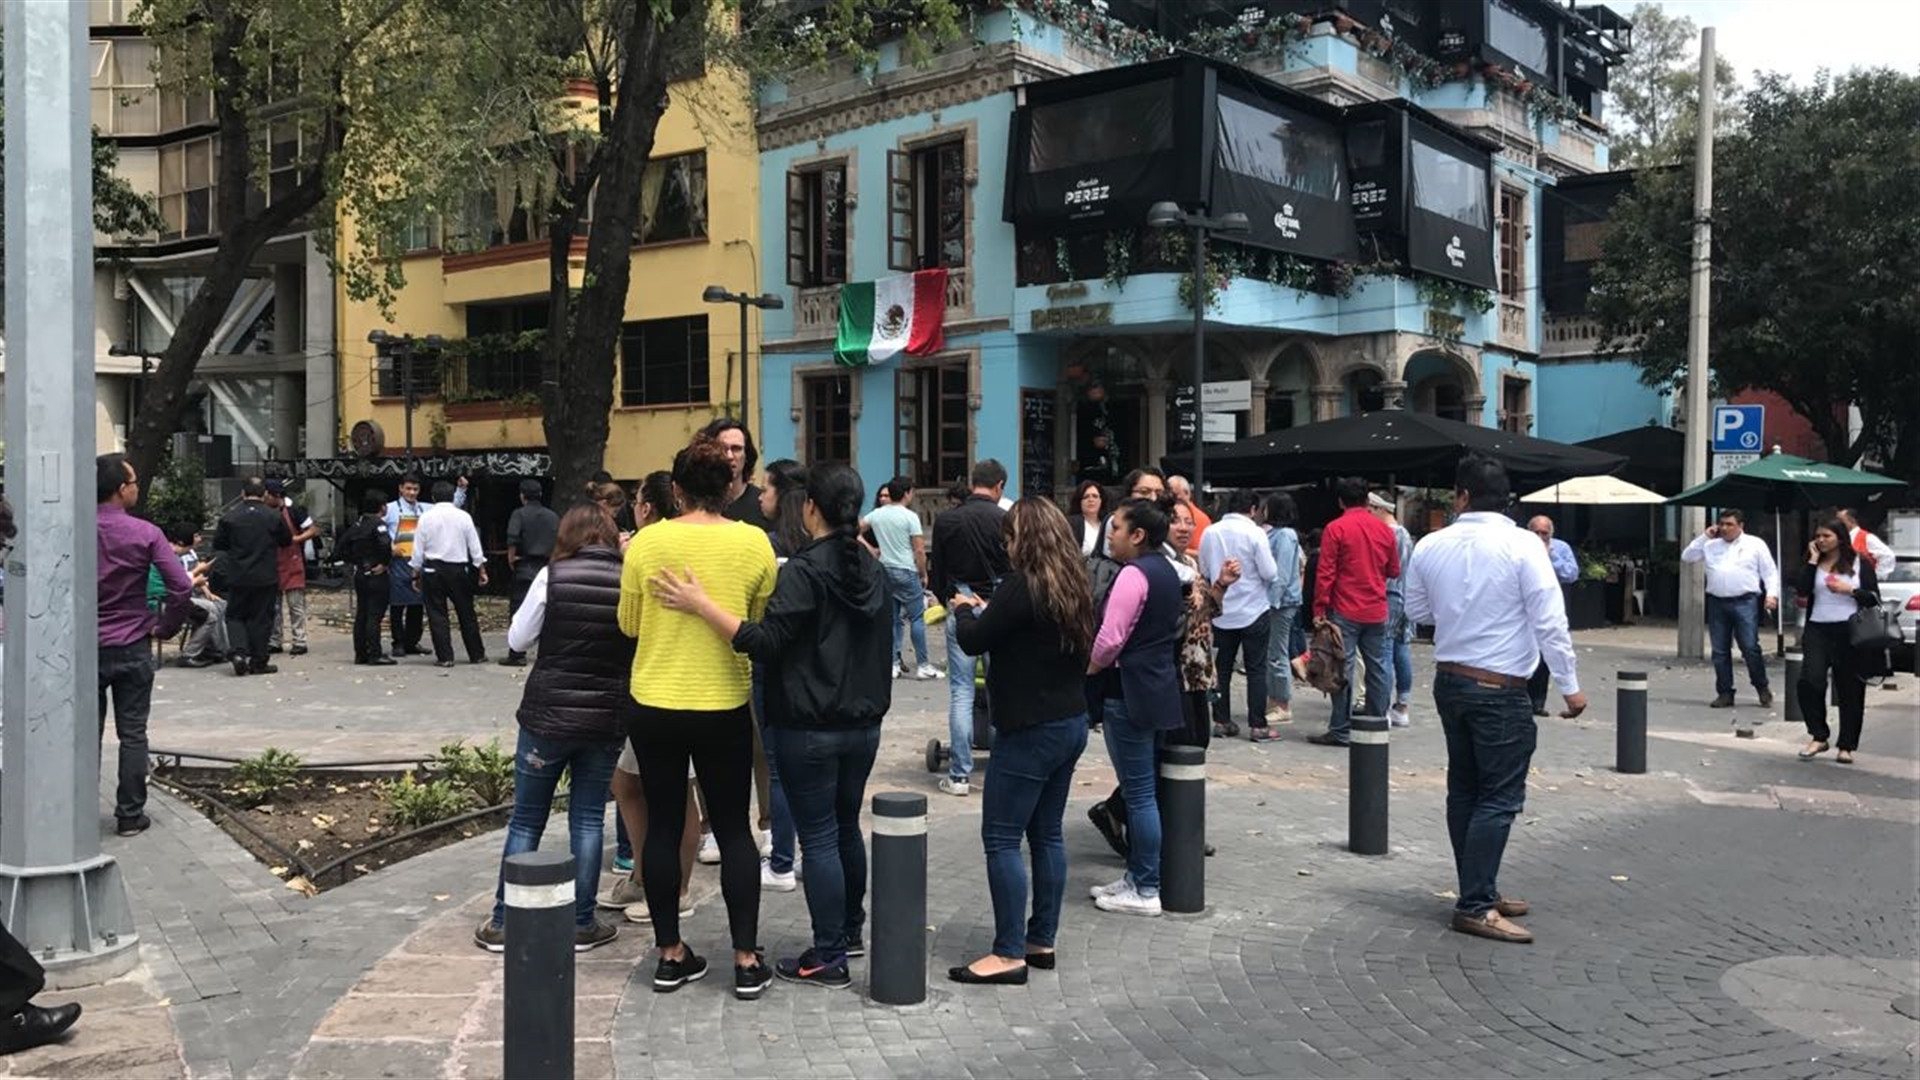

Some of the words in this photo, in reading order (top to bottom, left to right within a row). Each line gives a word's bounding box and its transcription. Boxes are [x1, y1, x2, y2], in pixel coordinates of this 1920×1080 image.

[1064, 185, 1110, 205] PEREZ
[1352, 188, 1387, 205] EREZ
[1717, 409, 1744, 441] P
